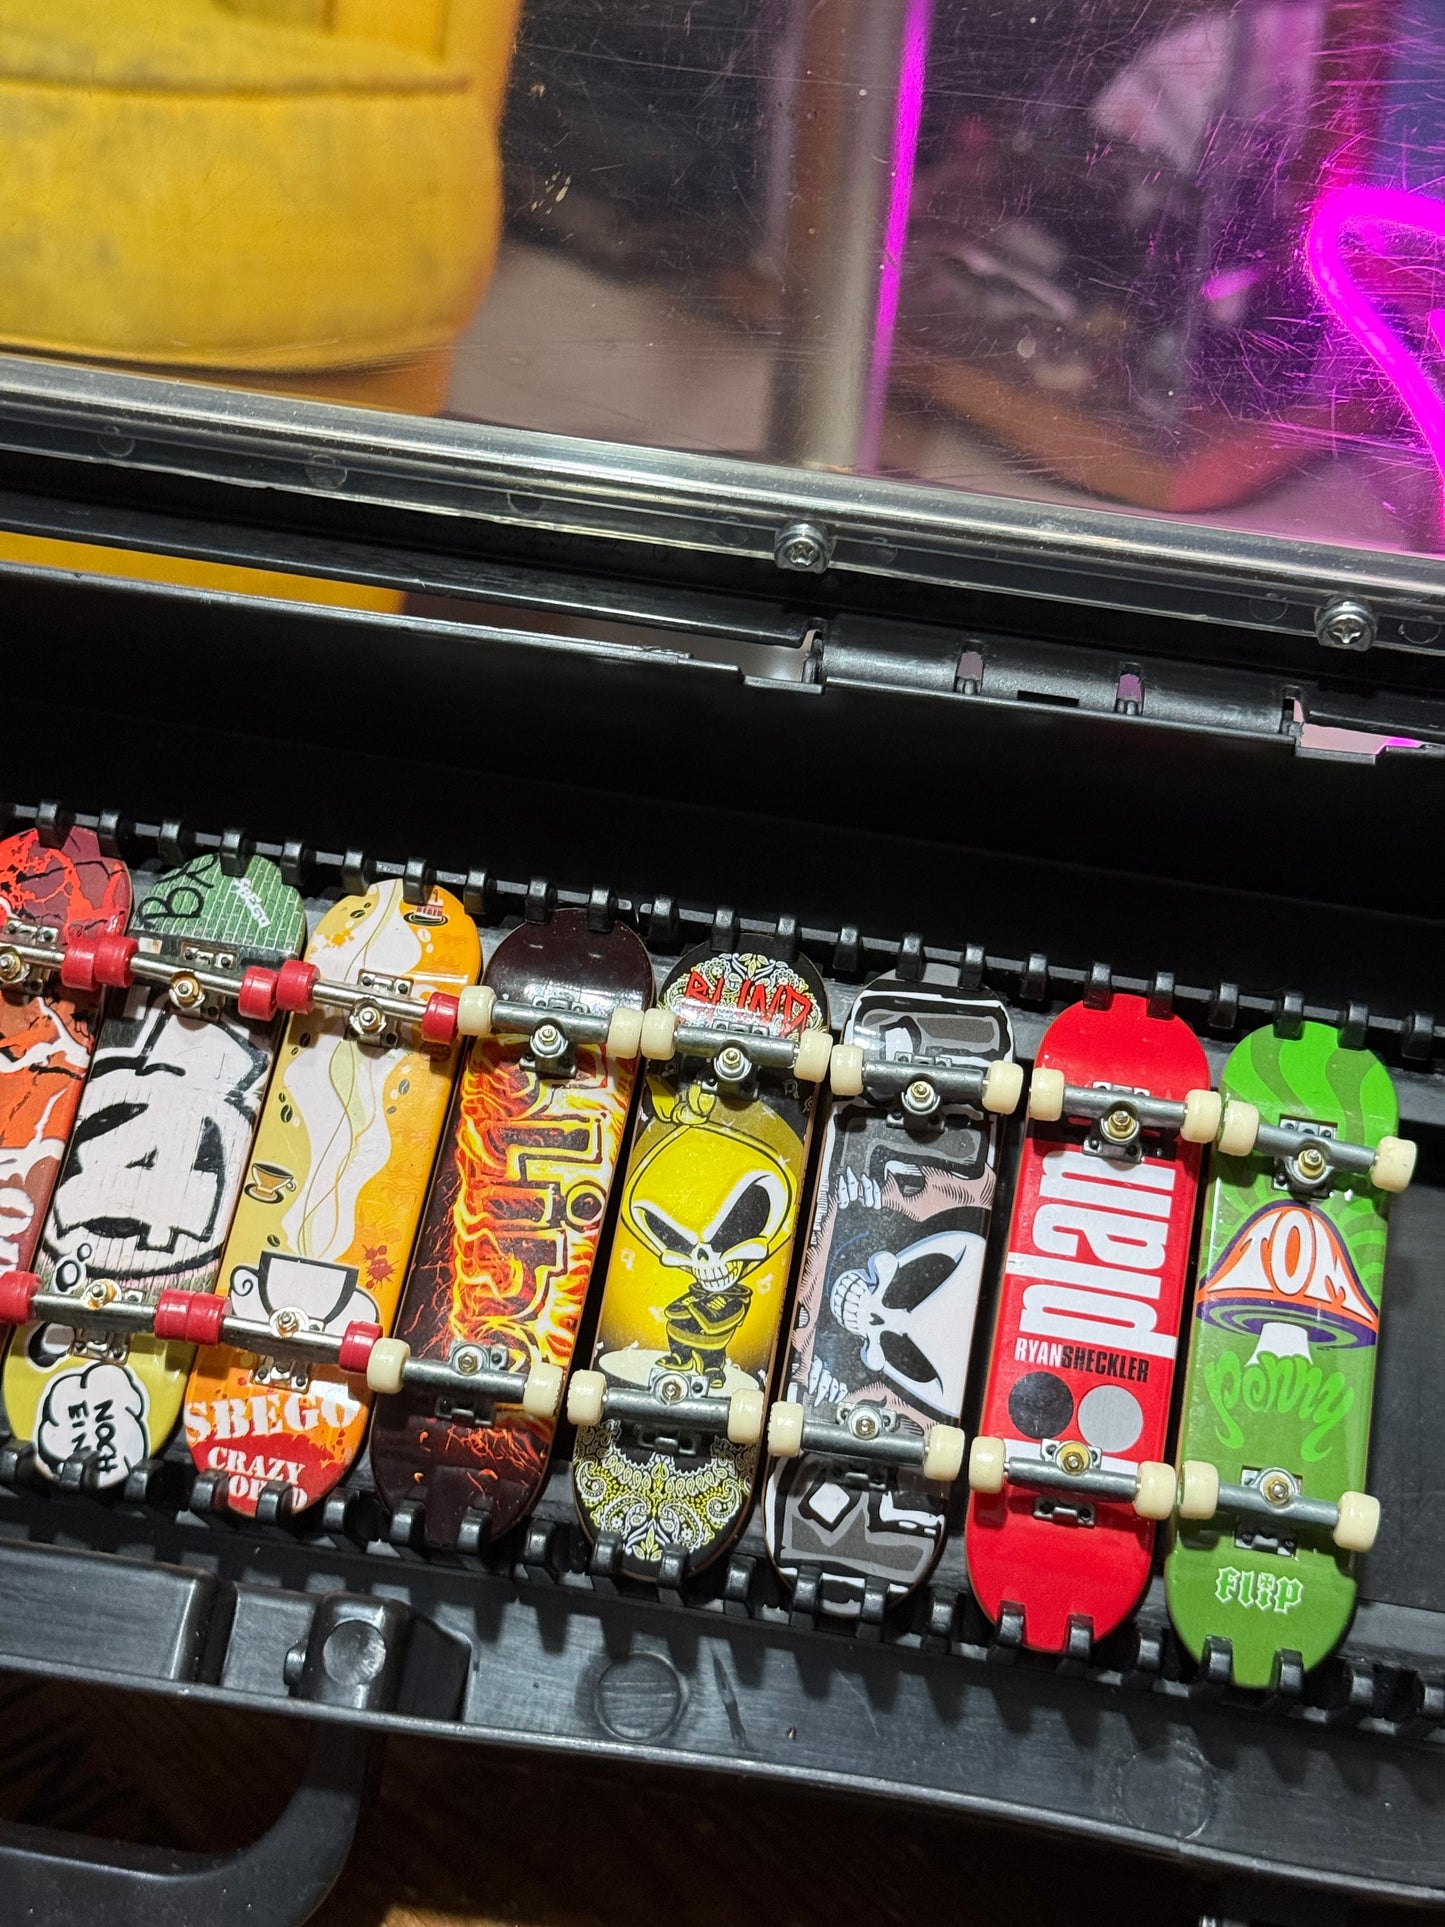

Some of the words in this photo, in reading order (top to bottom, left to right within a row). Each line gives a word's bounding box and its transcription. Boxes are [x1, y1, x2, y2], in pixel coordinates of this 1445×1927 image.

[1205, 1209, 1374, 1324] TOM
[184, 1393, 361, 1442] SBEGO
[207, 1446, 306, 1485] CRAZY
